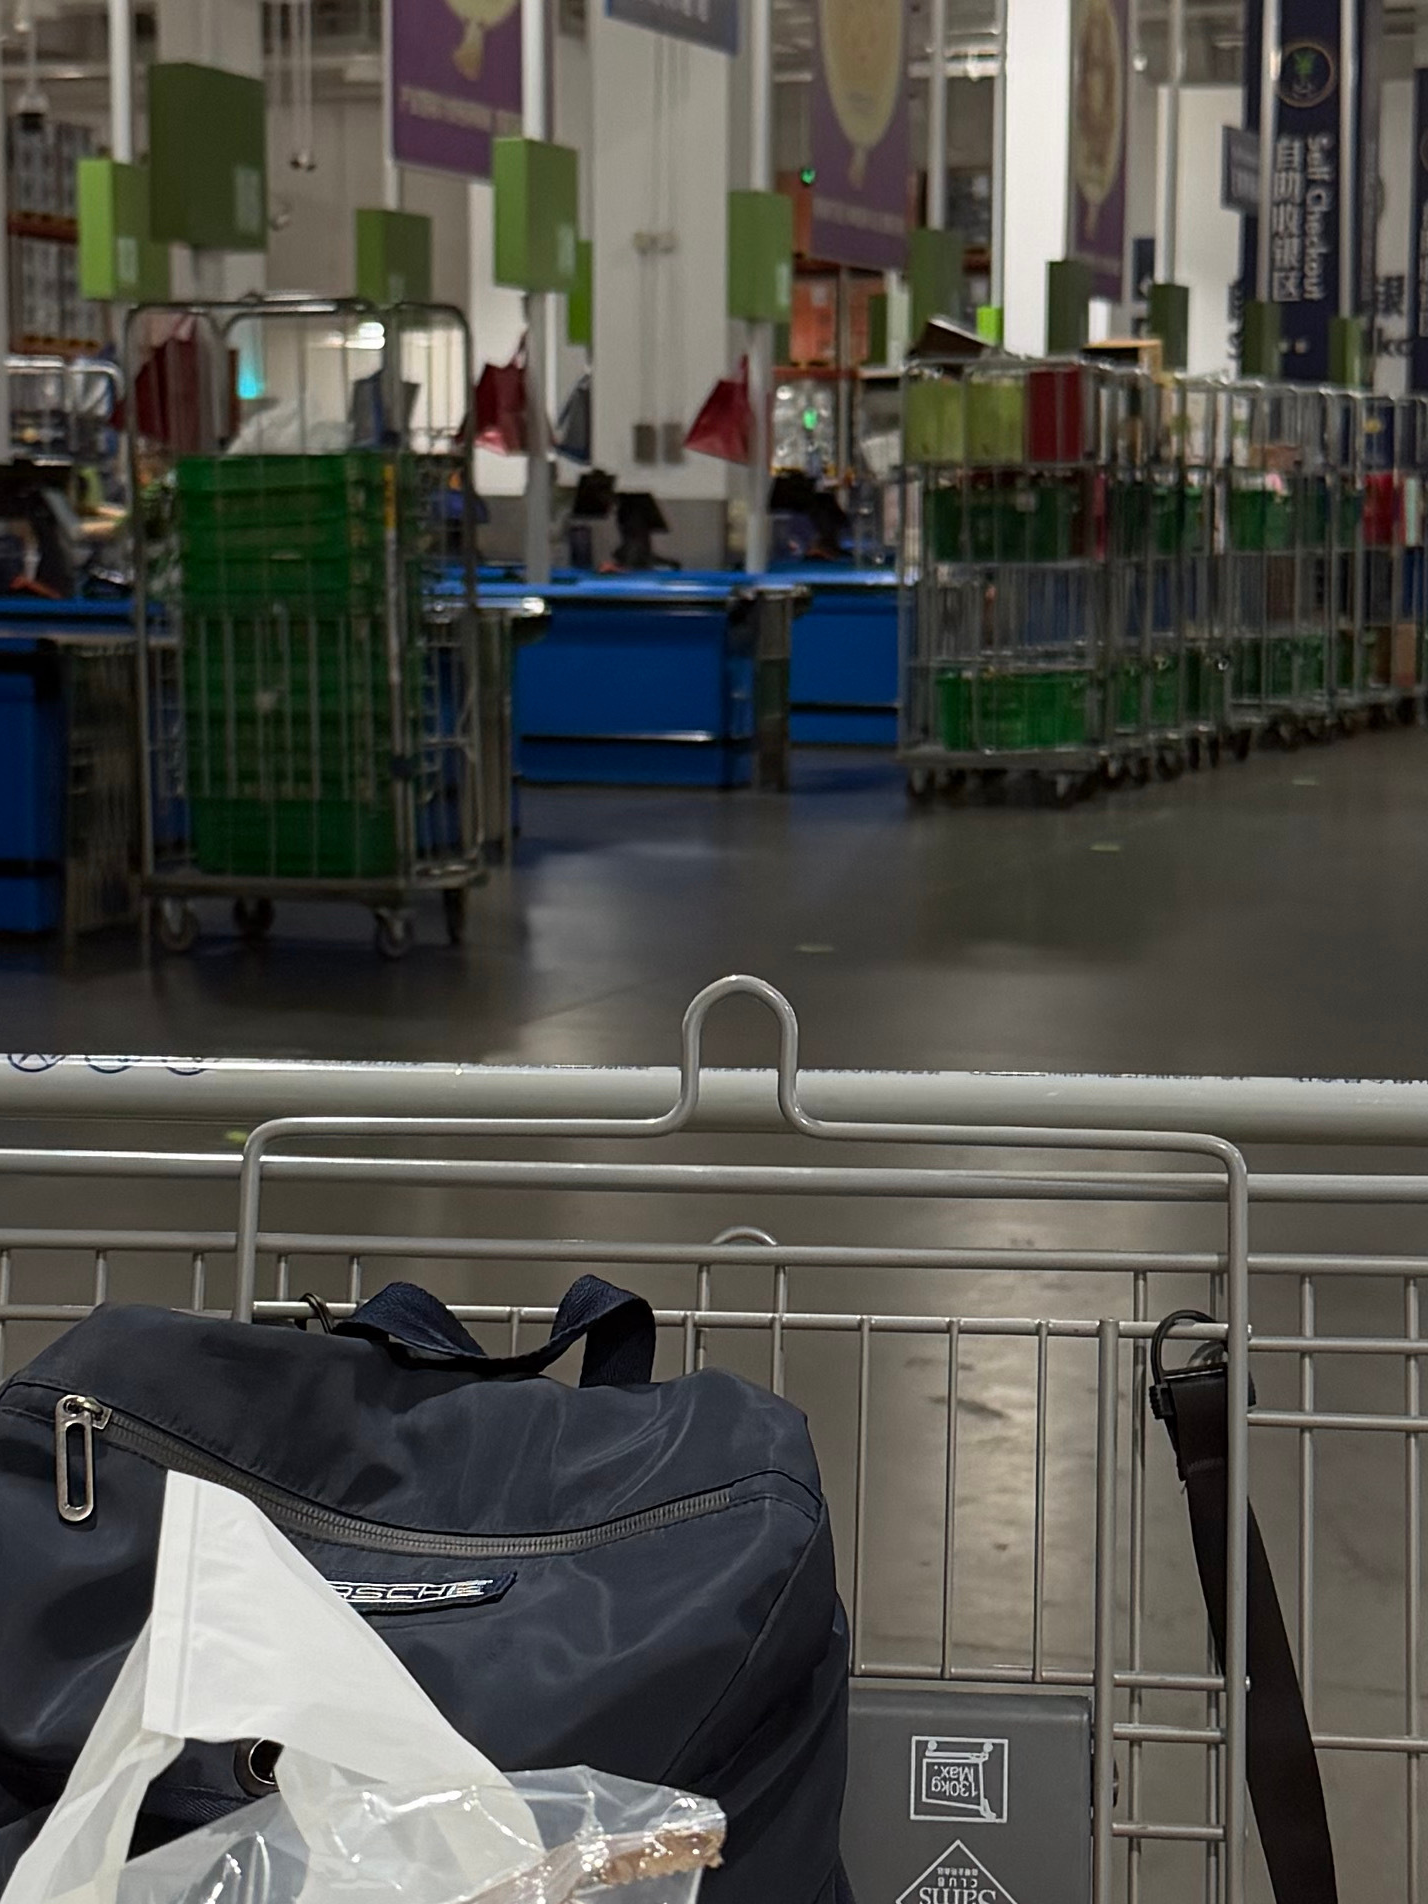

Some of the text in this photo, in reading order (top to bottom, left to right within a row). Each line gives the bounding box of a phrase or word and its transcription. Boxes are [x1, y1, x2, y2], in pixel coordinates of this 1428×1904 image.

[1272, 134, 1306, 302] 自助收银区
[1303, 135, 1334, 300] Self Checkout
[933, 1764, 974, 1779] Max.
[931, 1778, 979, 1797] 130kg
[937, 1877, 979, 1888] CLUB
